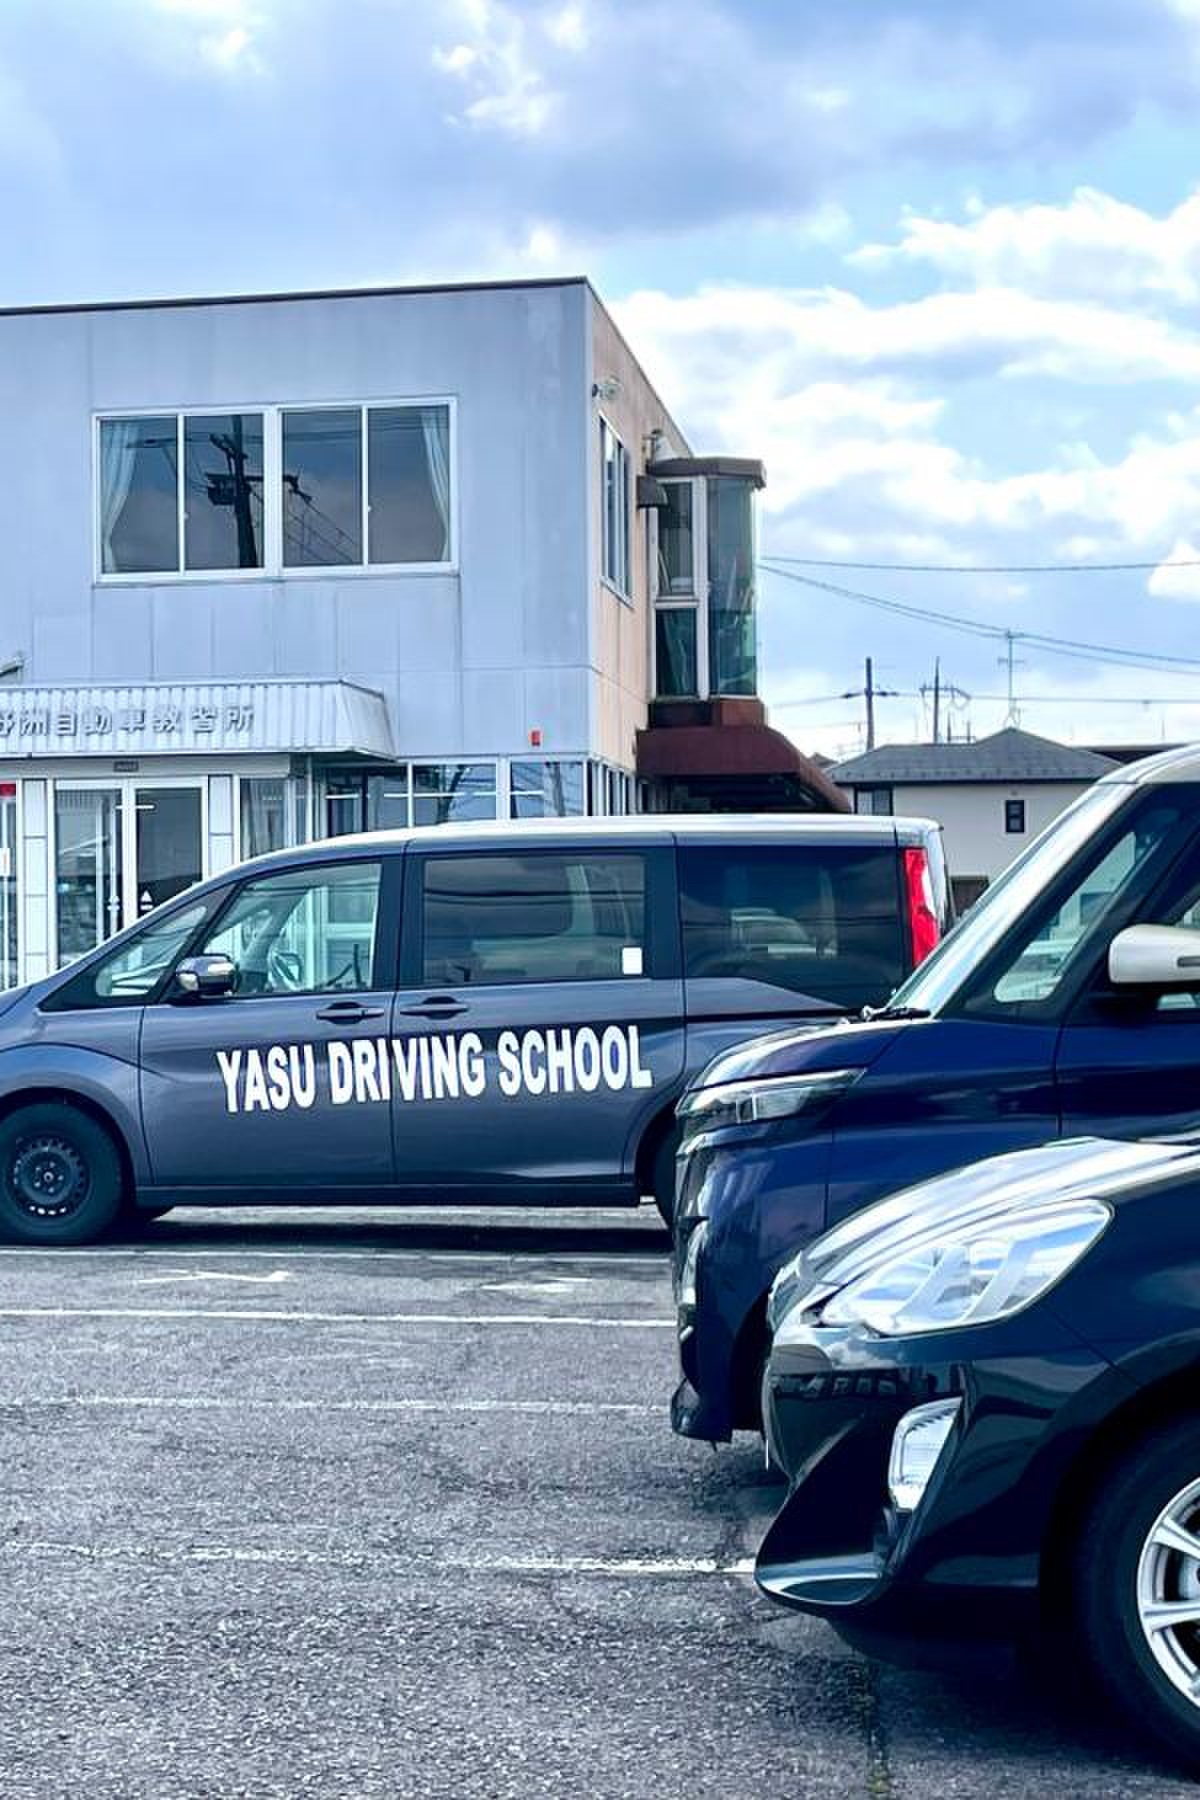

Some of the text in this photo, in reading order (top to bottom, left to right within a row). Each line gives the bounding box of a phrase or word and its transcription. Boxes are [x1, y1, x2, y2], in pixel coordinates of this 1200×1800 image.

[217, 1025, 652, 1113] YASU DRIVING SCHOOL
